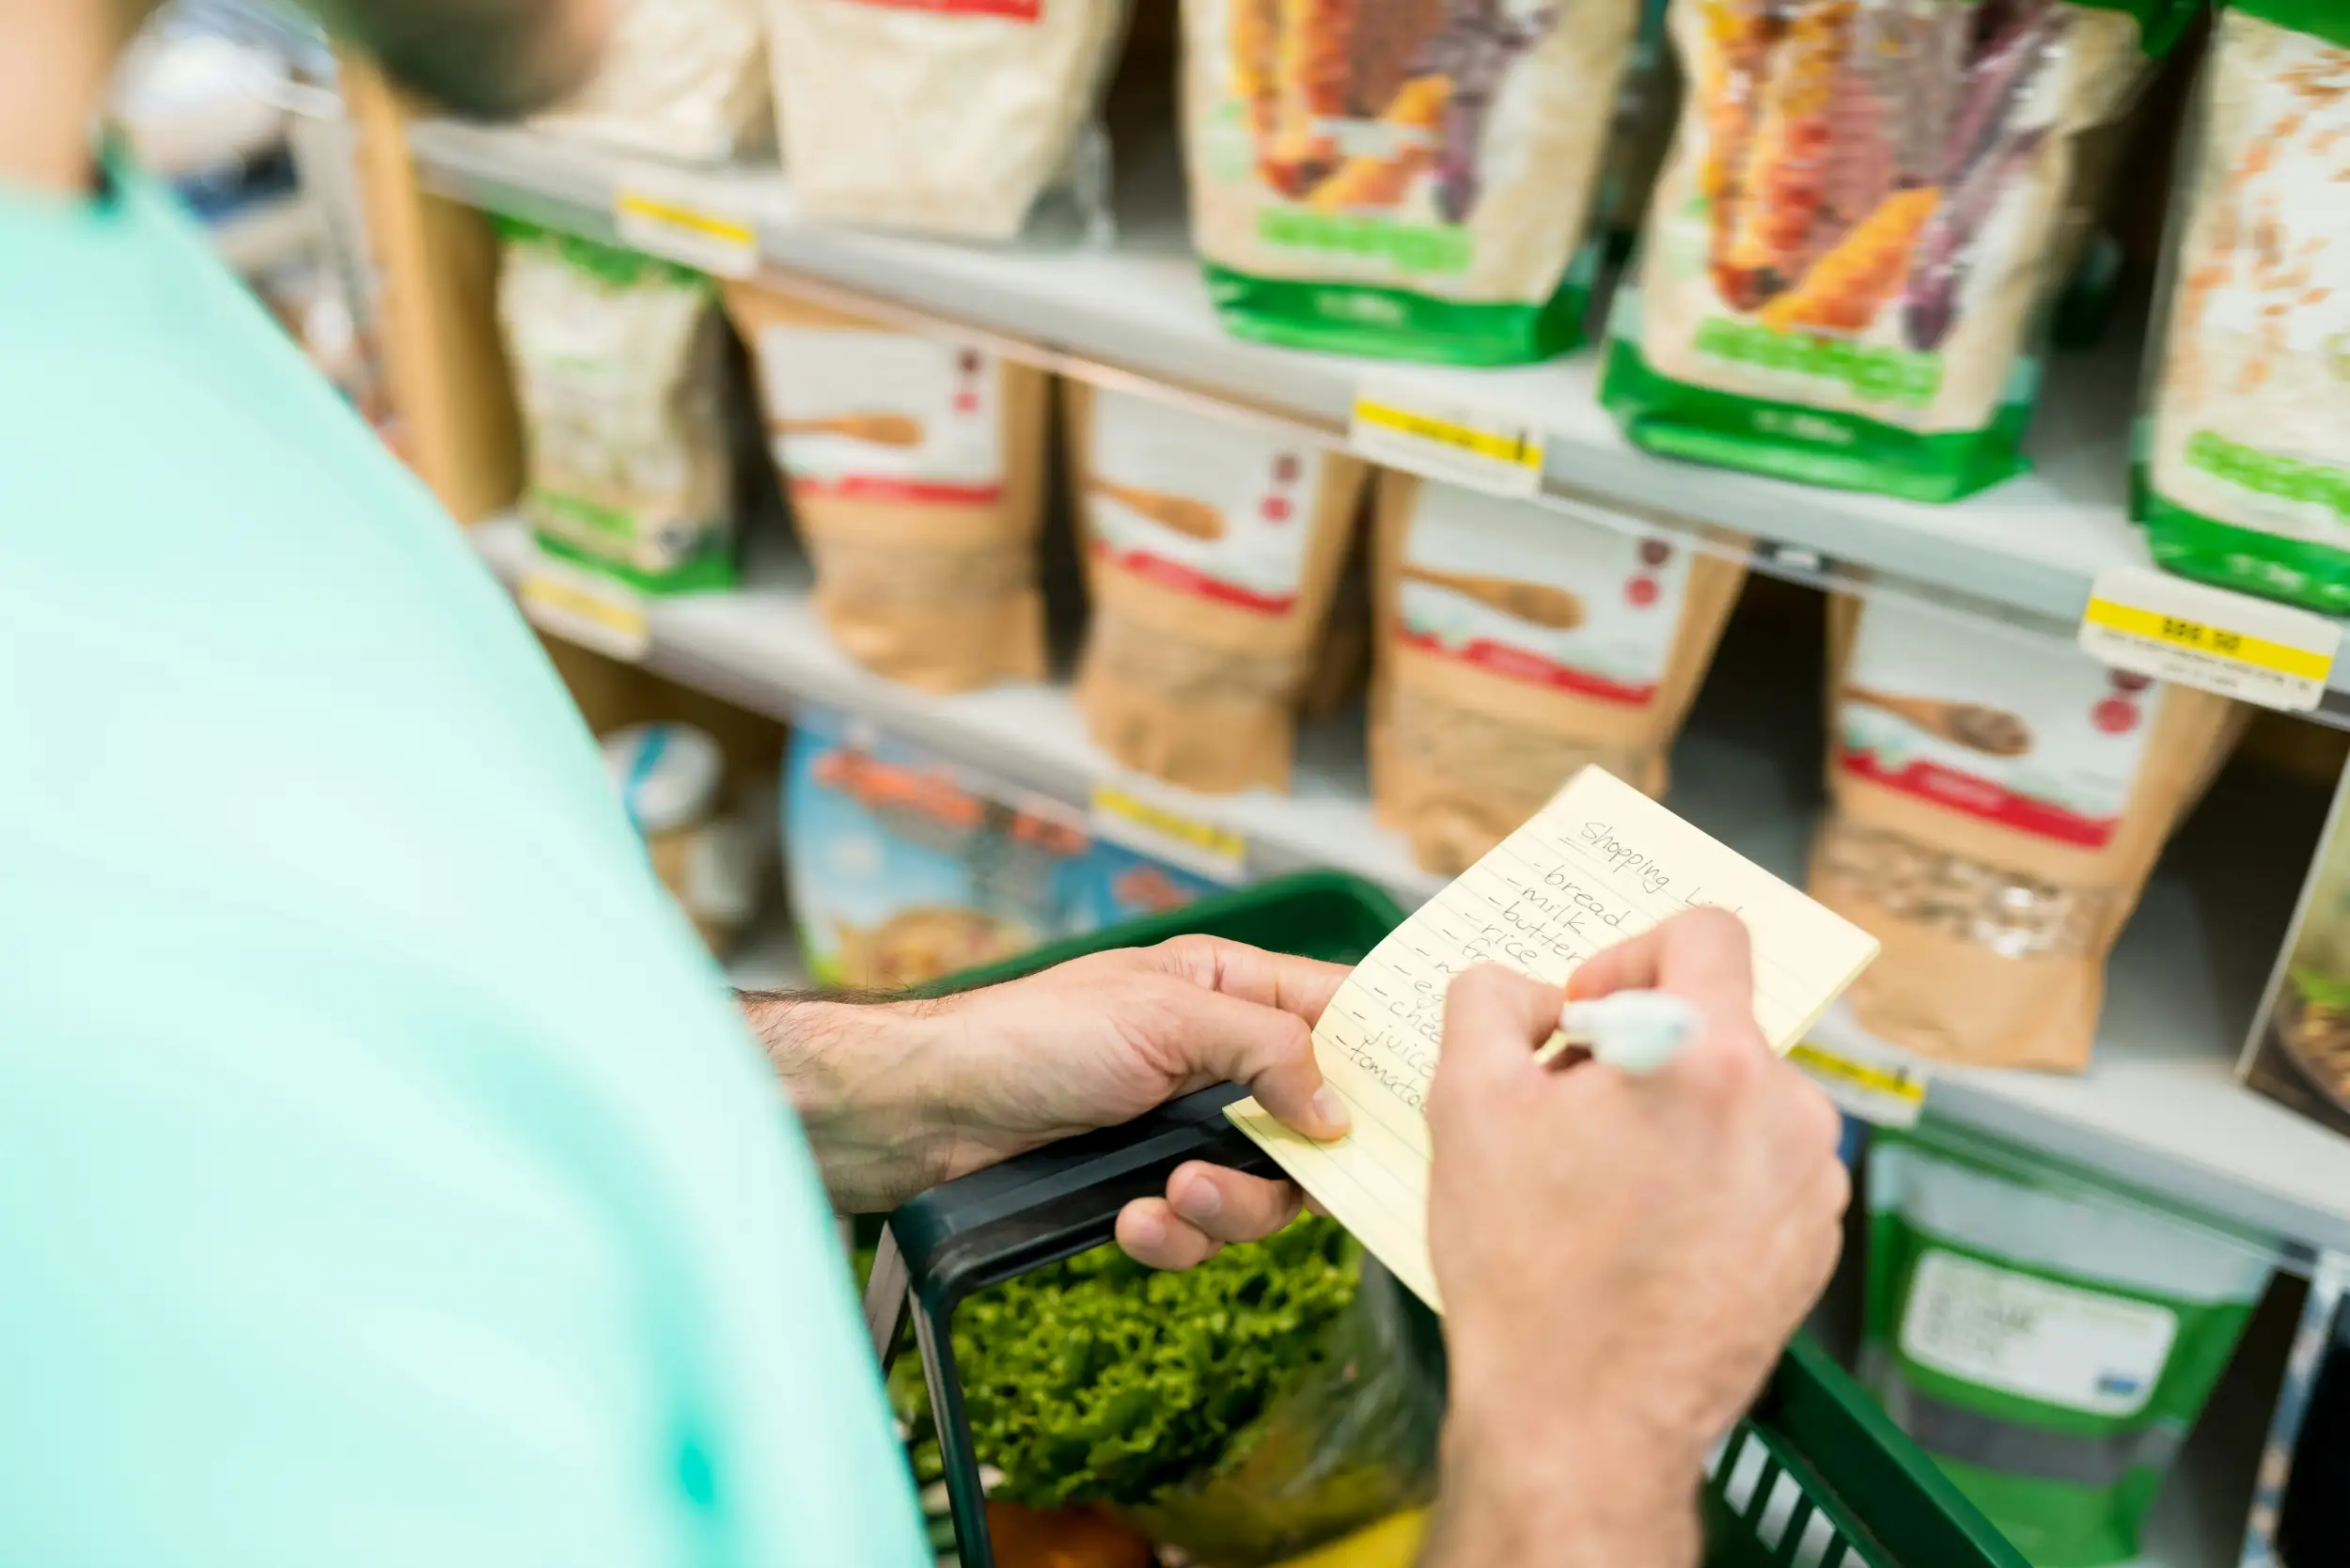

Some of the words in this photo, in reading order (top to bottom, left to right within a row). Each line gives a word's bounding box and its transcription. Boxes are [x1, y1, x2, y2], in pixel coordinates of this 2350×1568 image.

[1581, 822, 1669, 894] Shopping
[1522, 887, 1586, 934] milk
[1544, 865, 1631, 926] bread
[1481, 923, 1538, 964] rice
[1502, 901, 1588, 961] butter
[1364, 1024, 1438, 1079] juice
